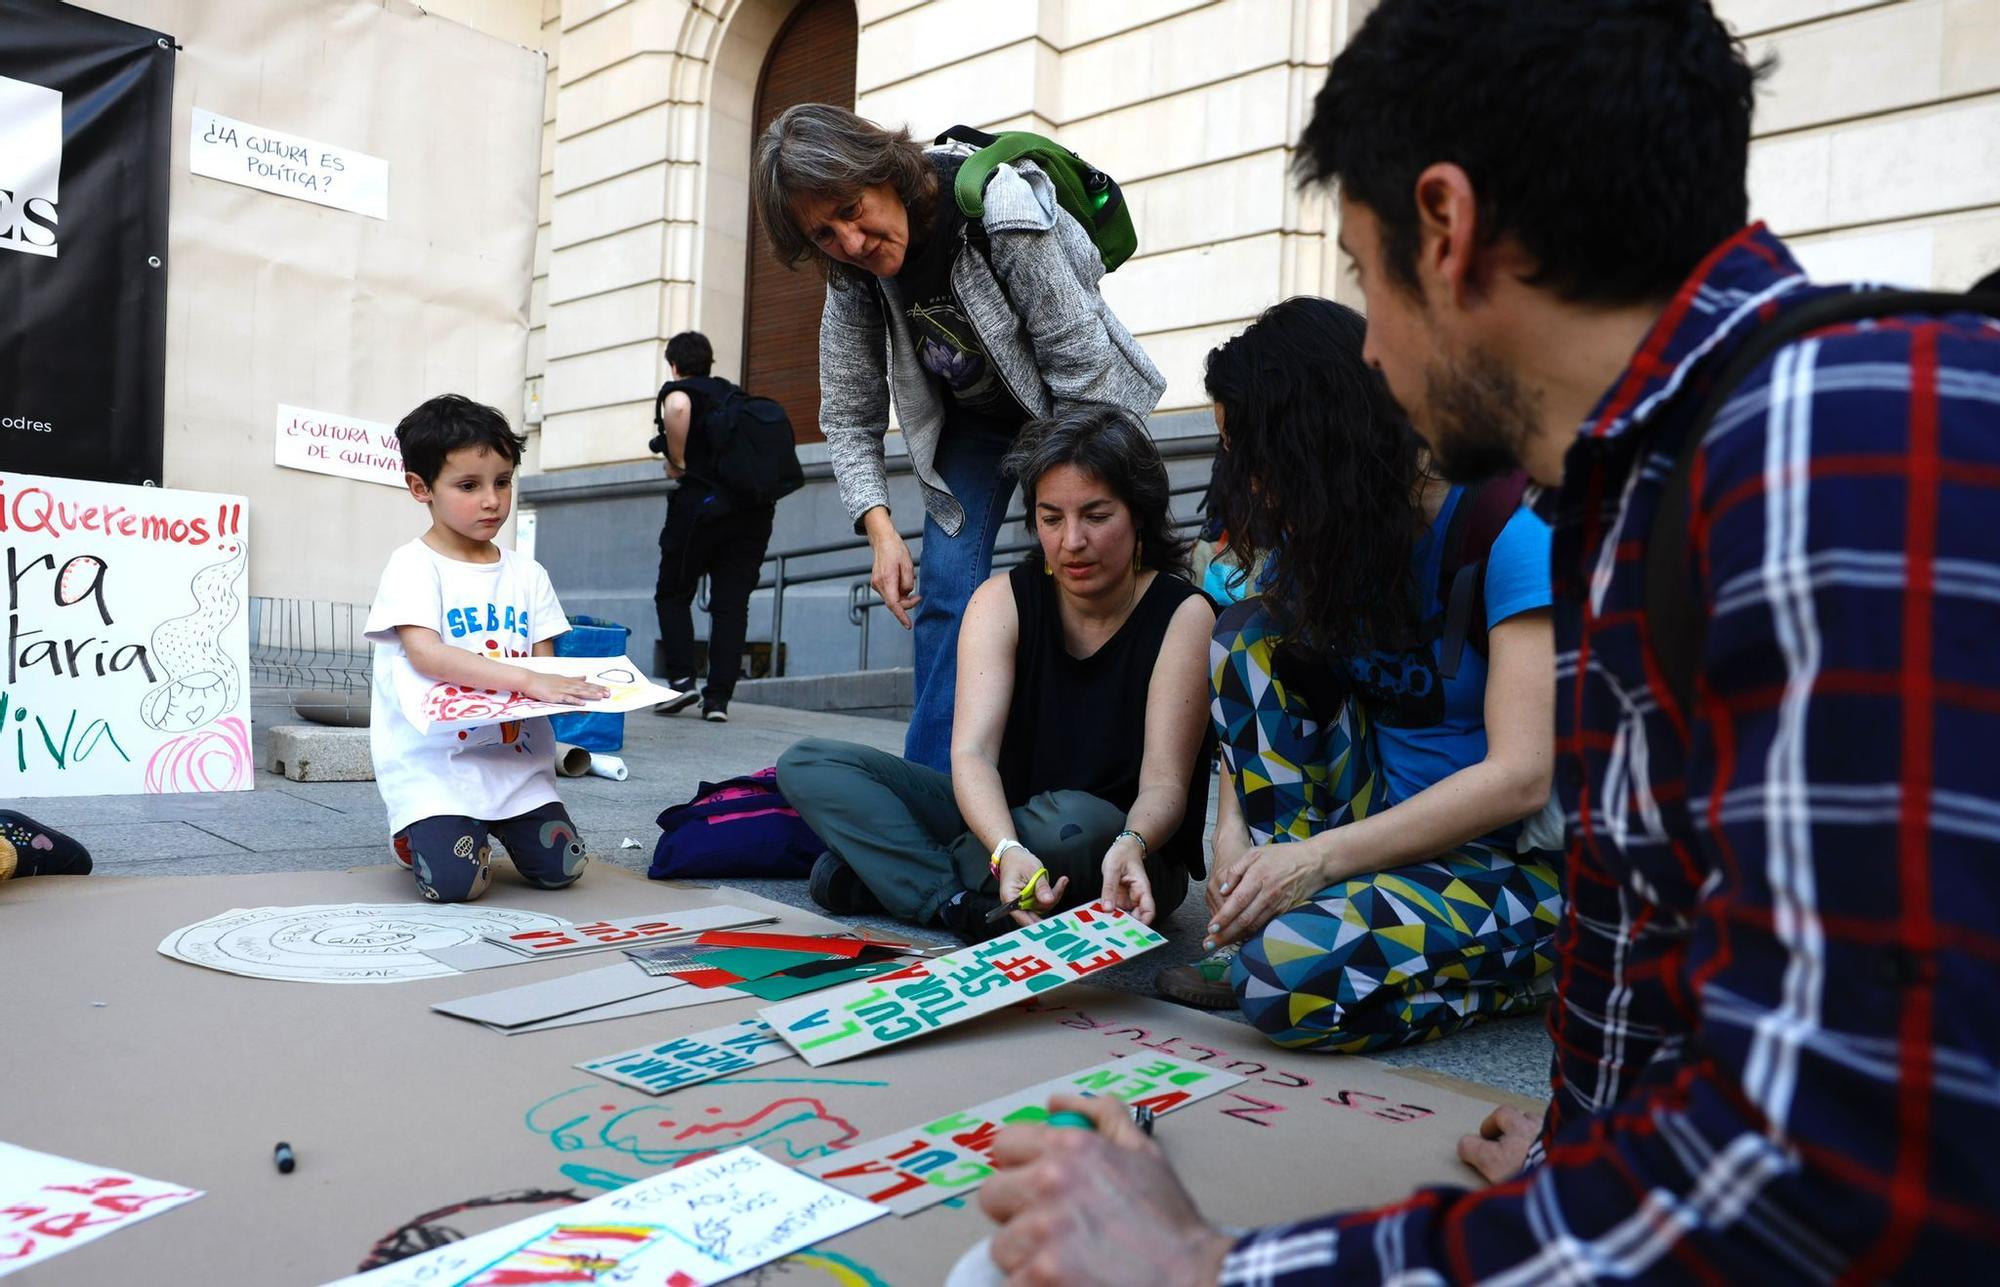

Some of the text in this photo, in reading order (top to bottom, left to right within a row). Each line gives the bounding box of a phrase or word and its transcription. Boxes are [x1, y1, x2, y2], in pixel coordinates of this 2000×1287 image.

[203, 119, 345, 172] ¿LA CULTURA ES
[2, 415, 52, 433] odres
[287, 414, 369, 444] ¿CULTURA
[308, 444, 330, 459] DE
[844, 987, 922, 1041] CUL
[867, 961, 967, 1028] TURA
[788, 1008, 863, 1051] LA
[1134, 1059, 1210, 1086] DE
[822, 1160, 929, 1203] LA
[885, 1139, 995, 1188] CUL
